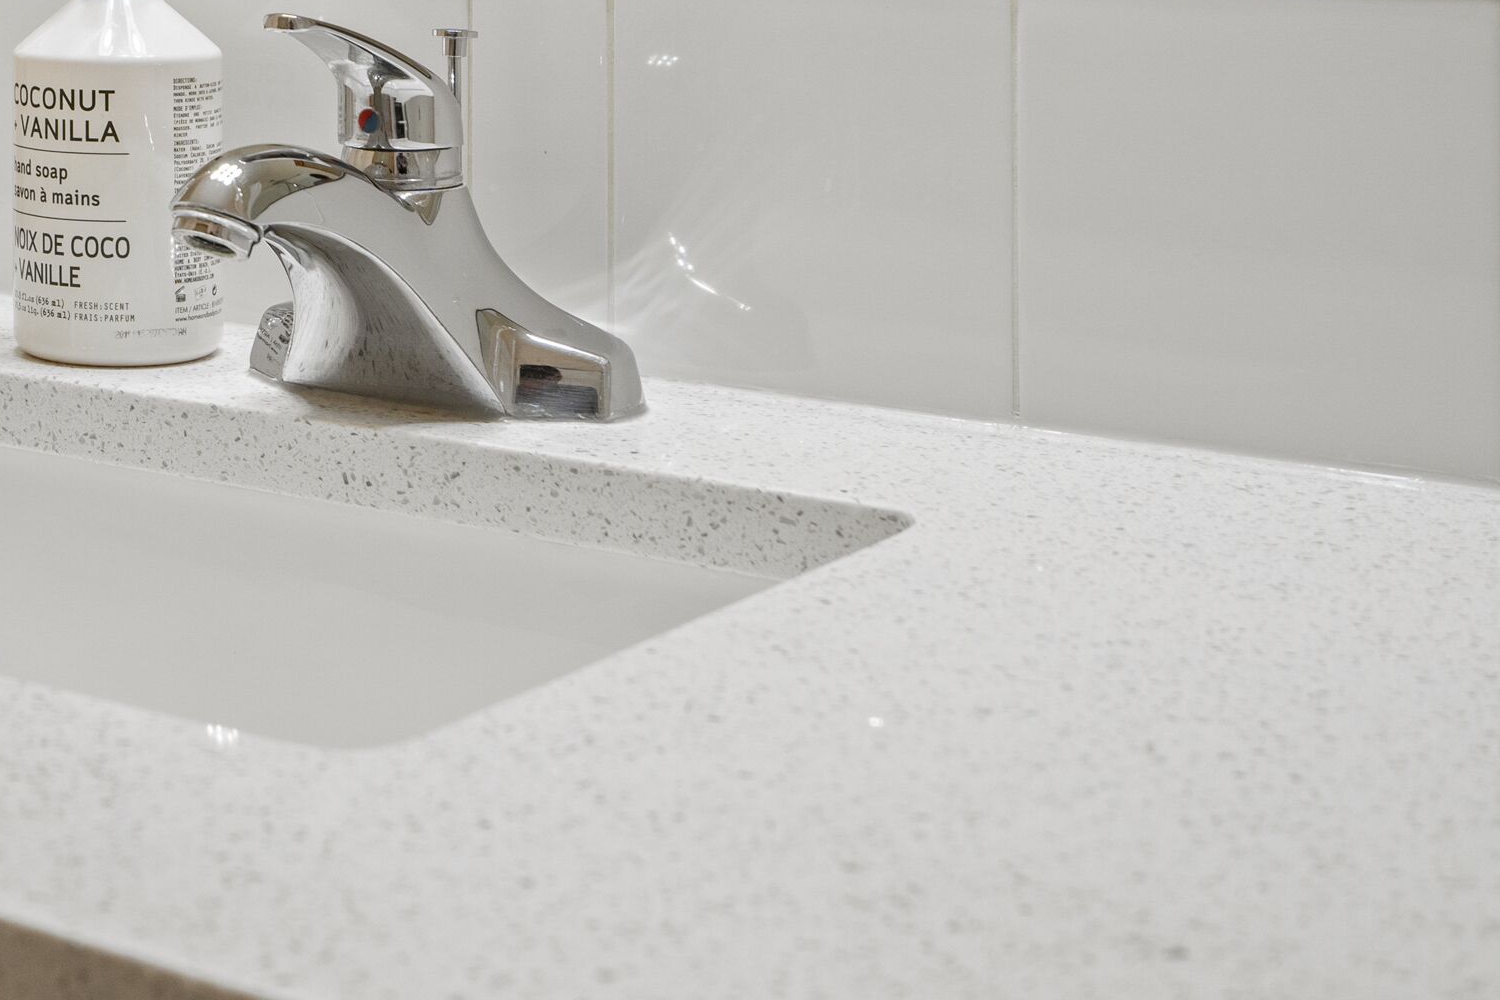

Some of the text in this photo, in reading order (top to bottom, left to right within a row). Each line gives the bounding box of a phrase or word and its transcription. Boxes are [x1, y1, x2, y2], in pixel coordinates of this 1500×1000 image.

[14, 82, 115, 112] COCONUT
[20, 114, 120, 143] VANILLA
[35, 164, 68, 185] soap
[14, 185, 100, 207] savon à mains
[15, 226, 130, 259] NOIX DE COCO
[19, 257, 81, 288] VANILLE
